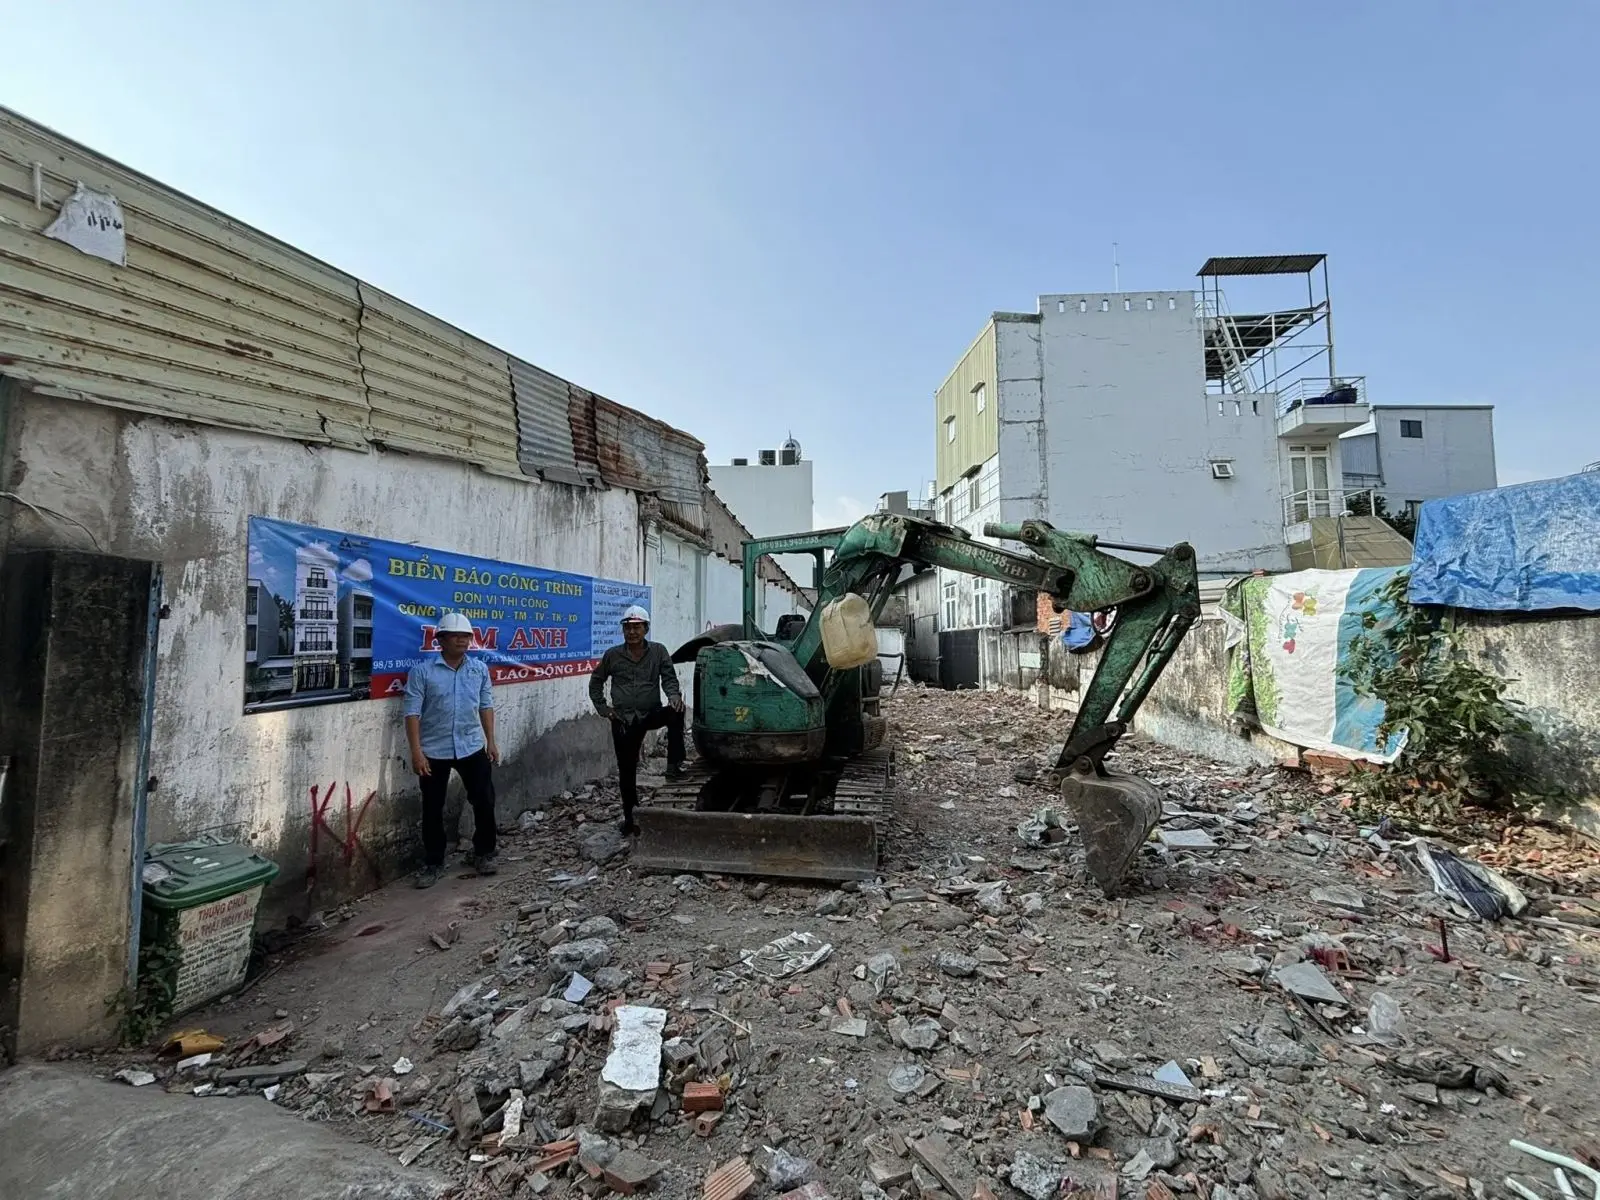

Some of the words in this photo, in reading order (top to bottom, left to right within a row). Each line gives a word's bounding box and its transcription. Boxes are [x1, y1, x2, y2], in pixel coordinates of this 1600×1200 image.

[389, 553, 447, 580] BIỂN
[498, 572, 540, 592] CÔNG
[544, 581, 583, 597] TRÌNH
[454, 591, 482, 605] ĐƠN
[501, 596, 518, 607] THI
[521, 594, 549, 609] CÔNG
[399, 601, 436, 618] CÔNG
[459, 608, 488, 620] TNHH
[514, 610, 527, 621] TM
[418, 624, 499, 652] KM
[507, 627, 569, 650] ANH
[373, 660, 394, 670] 98/5
[496, 669, 529, 681] LAO
[534, 663, 574, 678] ĐỘNG
[577, 660, 593, 673] LÀ
